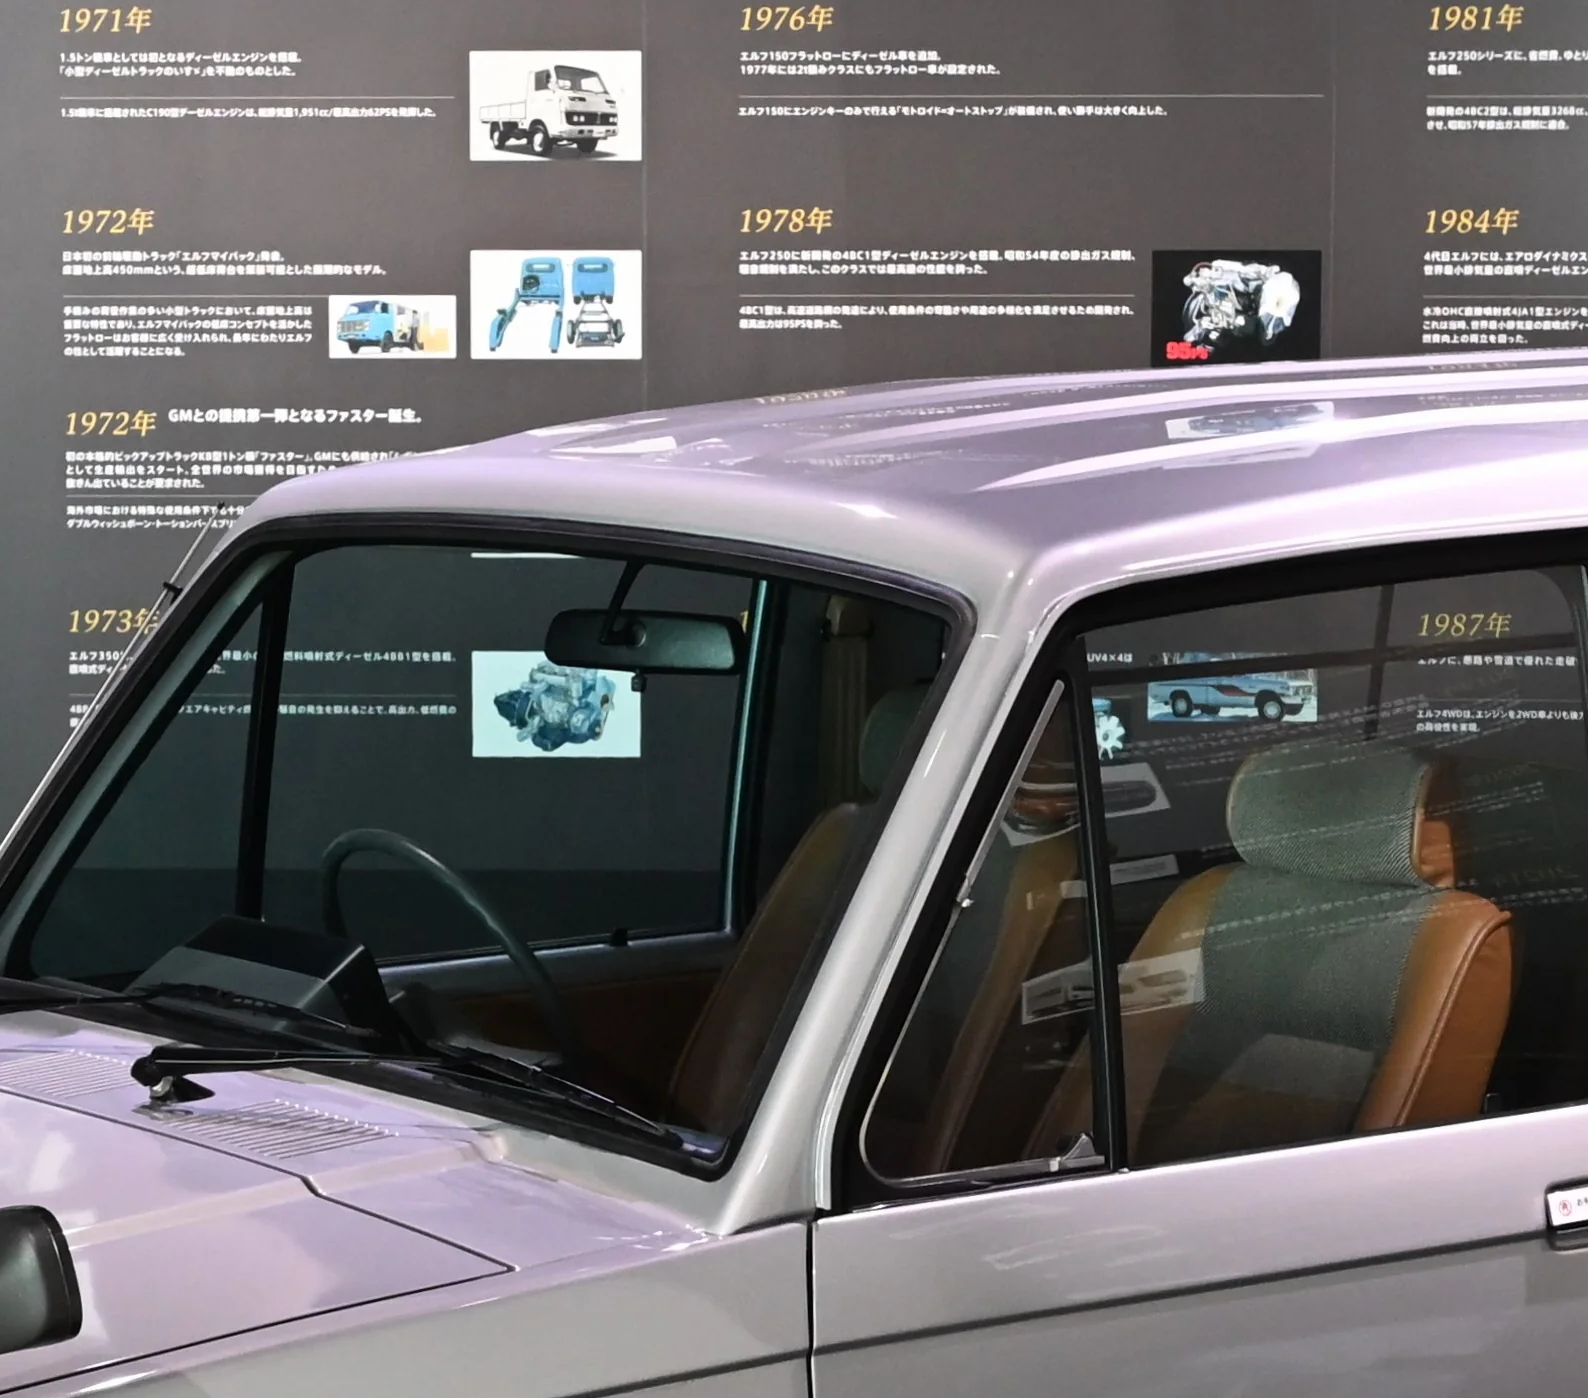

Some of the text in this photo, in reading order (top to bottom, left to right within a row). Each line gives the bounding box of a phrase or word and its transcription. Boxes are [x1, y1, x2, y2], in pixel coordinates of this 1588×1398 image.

[60, 6, 153, 34] 1971年
[740, 5, 834, 32] 1976年
[1429, 3, 1524, 32] 1981年
[63, 207, 155, 236] 1972年
[740, 207, 834, 235] 1978年
[1425, 207, 1520, 235] 1984年
[66, 409, 157, 437] 1972年
[1418, 611, 1512, 640] 1987年
